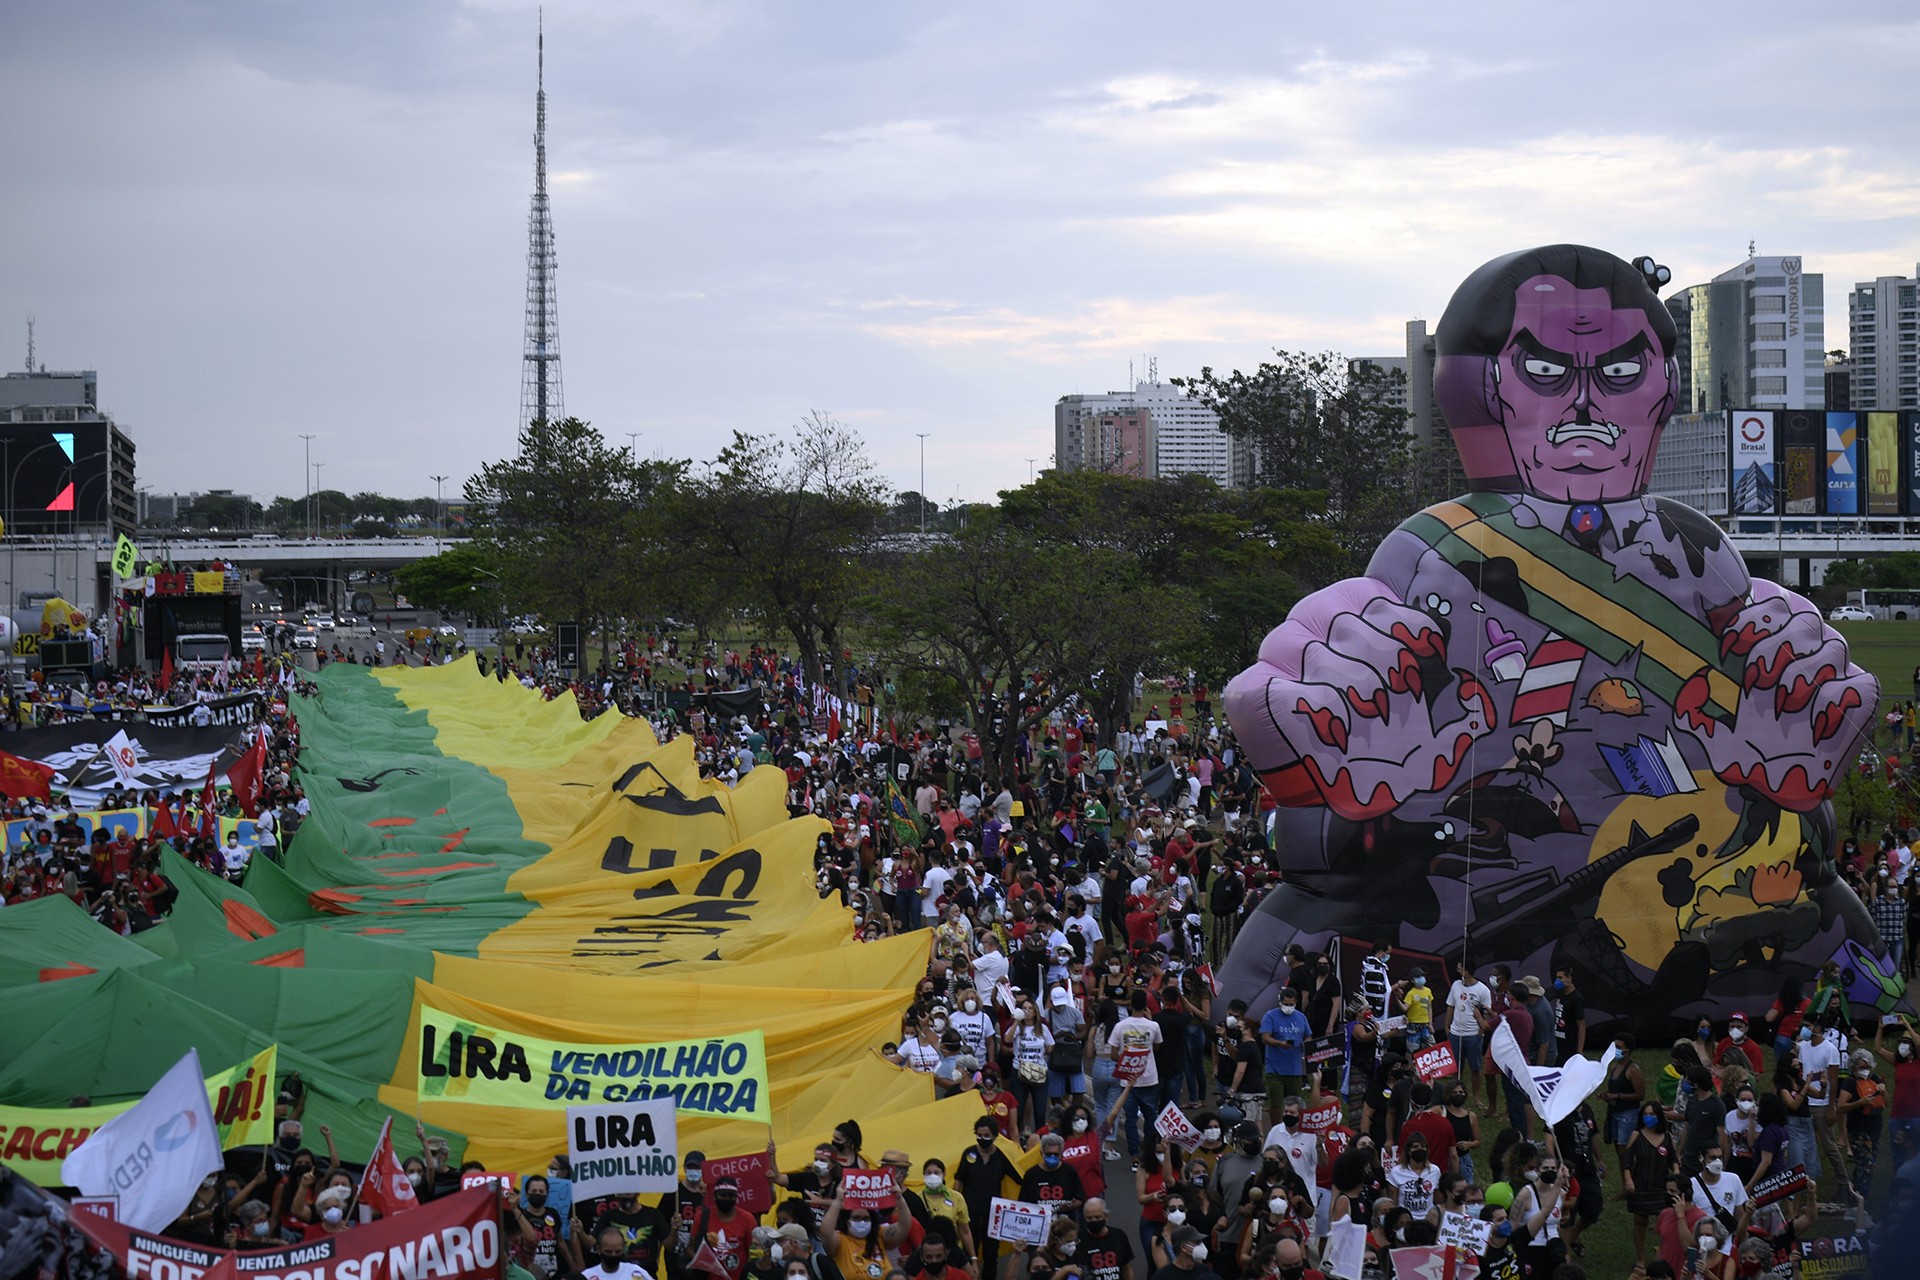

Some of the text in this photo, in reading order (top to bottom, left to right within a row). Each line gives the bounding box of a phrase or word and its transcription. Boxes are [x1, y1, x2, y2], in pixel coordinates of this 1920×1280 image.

[1789, 276, 1799, 336] WINDSOR
[1741, 443, 1766, 451] Brasal
[1828, 481, 1856, 489] CAIXA
[421, 1024, 747, 1082] LIRA VENDILHÃO
[1121, 1055, 1148, 1067] FOR
[1416, 1047, 1451, 1068] FORA
[544, 1074, 758, 1113] DA CÂMARA
[1167, 1107, 1189, 1133] NÃO
[1302, 1105, 1337, 1122] FORA
[574, 1112, 656, 1152] LIRA
[1162, 1115, 1181, 1138] PEC
[571, 1148, 677, 1183] VENDILHÃO
[711, 1157, 762, 1177] CHEGA
[846, 1173, 893, 1189] FORA
[1753, 1170, 1793, 1192] GERAÇÃO
[1754, 1183, 1780, 1198] SEMPRE
[1040, 1186, 1064, 1200] 68
[1004, 1223, 1026, 1233] Arthur
[1014, 1216, 1032, 1226] FORA
[135, 1236, 331, 1271] NINGUÉM AUENTA MAIS
[1091, 1250, 1117, 1268] 68
[1801, 1254, 1868, 1273] BOLSONARO
